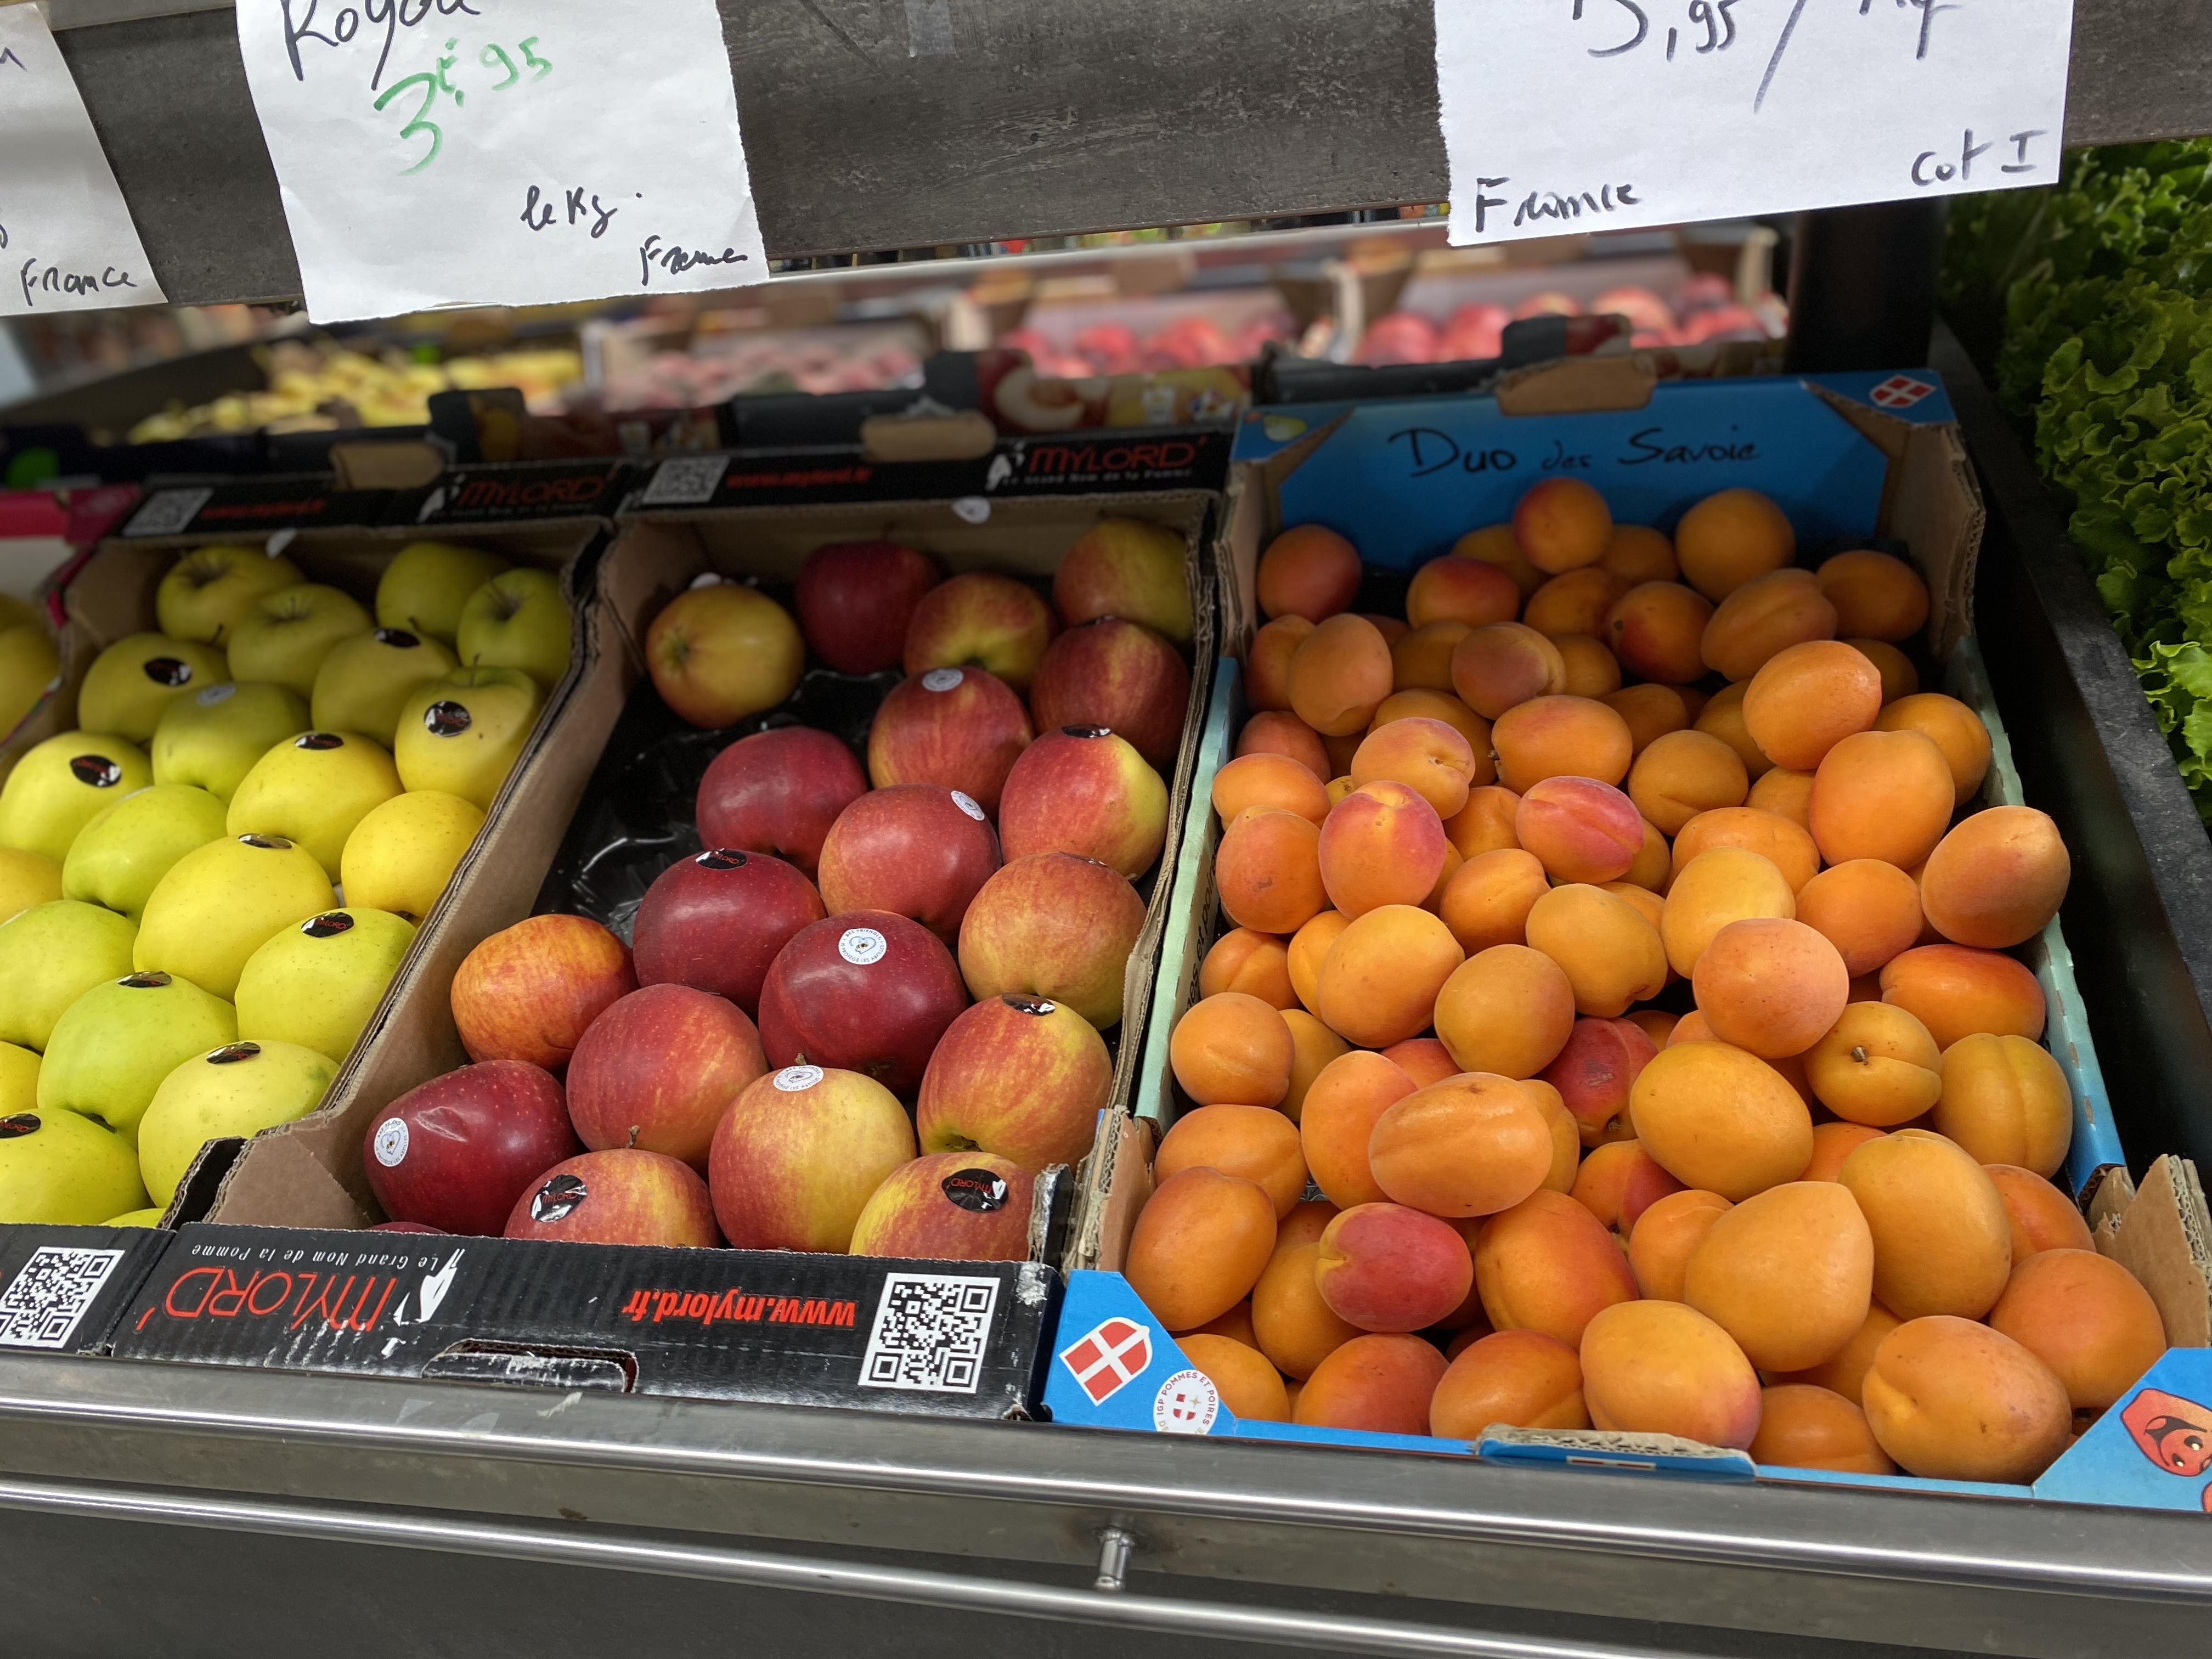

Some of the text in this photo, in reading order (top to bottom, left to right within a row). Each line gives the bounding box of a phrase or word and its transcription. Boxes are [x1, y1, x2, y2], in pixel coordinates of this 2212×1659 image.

[20, 258, 137, 306] France
[1388, 427, 1517, 478] Duo
[1617, 425, 1760, 465] Savoie
[950, 1177, 992, 1194] MYLORD
[192, 1244, 439, 1271] Le Grand Nom de la Pomme
[622, 1286, 856, 1327] www.mylord.fr
[1156, 1372, 1215, 1425] IGP POMMES ET POIRES
